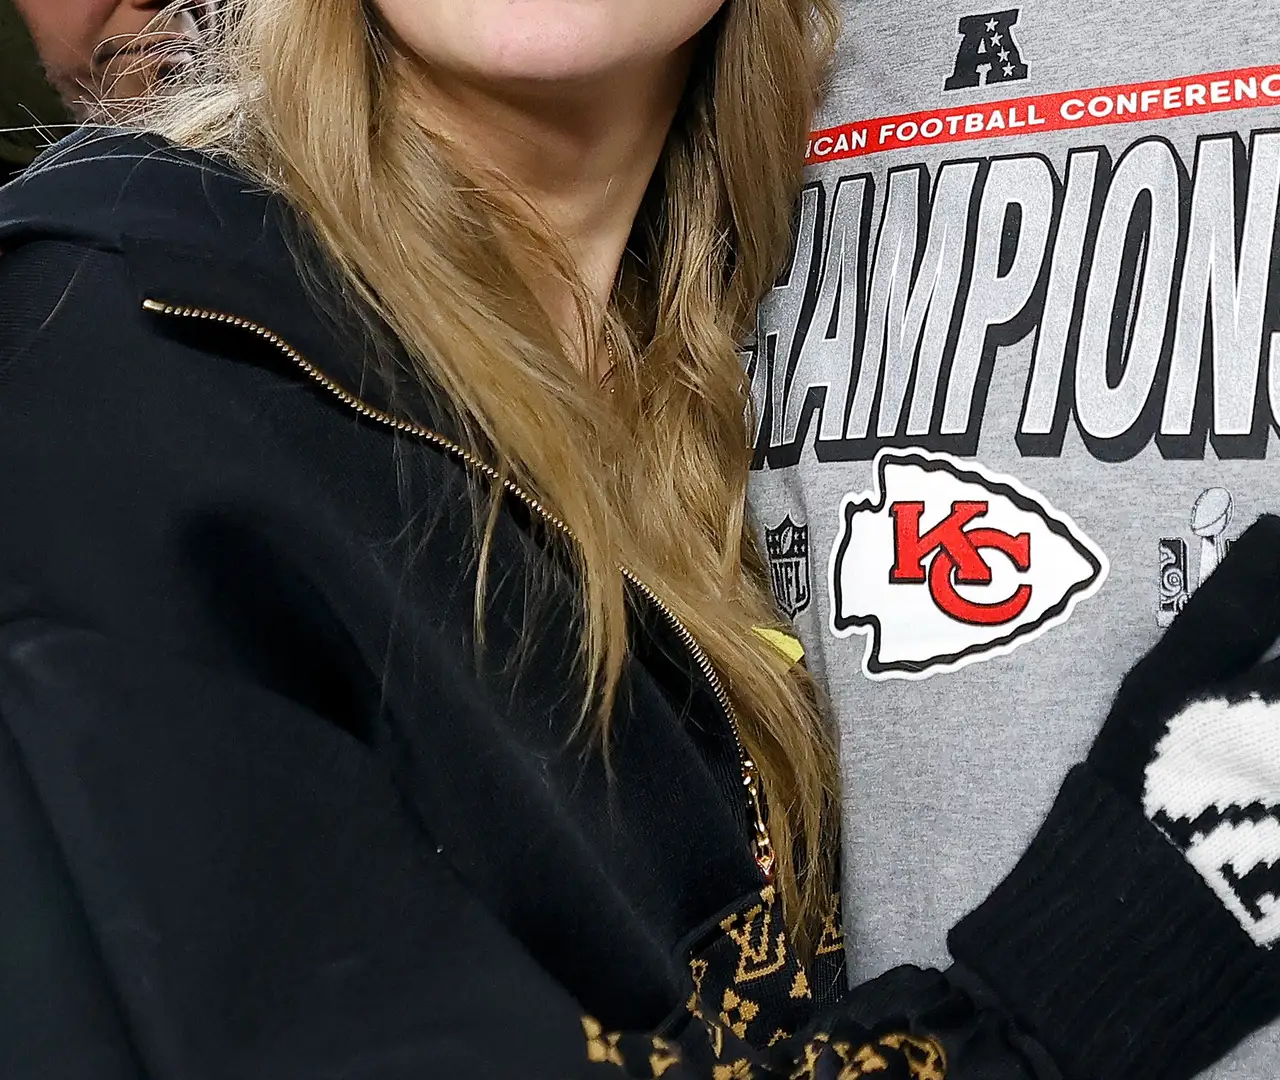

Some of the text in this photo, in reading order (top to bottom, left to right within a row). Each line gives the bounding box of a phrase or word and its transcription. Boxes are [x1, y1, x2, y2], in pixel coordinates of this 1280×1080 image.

[804, 128, 868, 159] ICAN
[878, 104, 1046, 145] FOOTBALL
[887, 499, 1033, 623] KC
